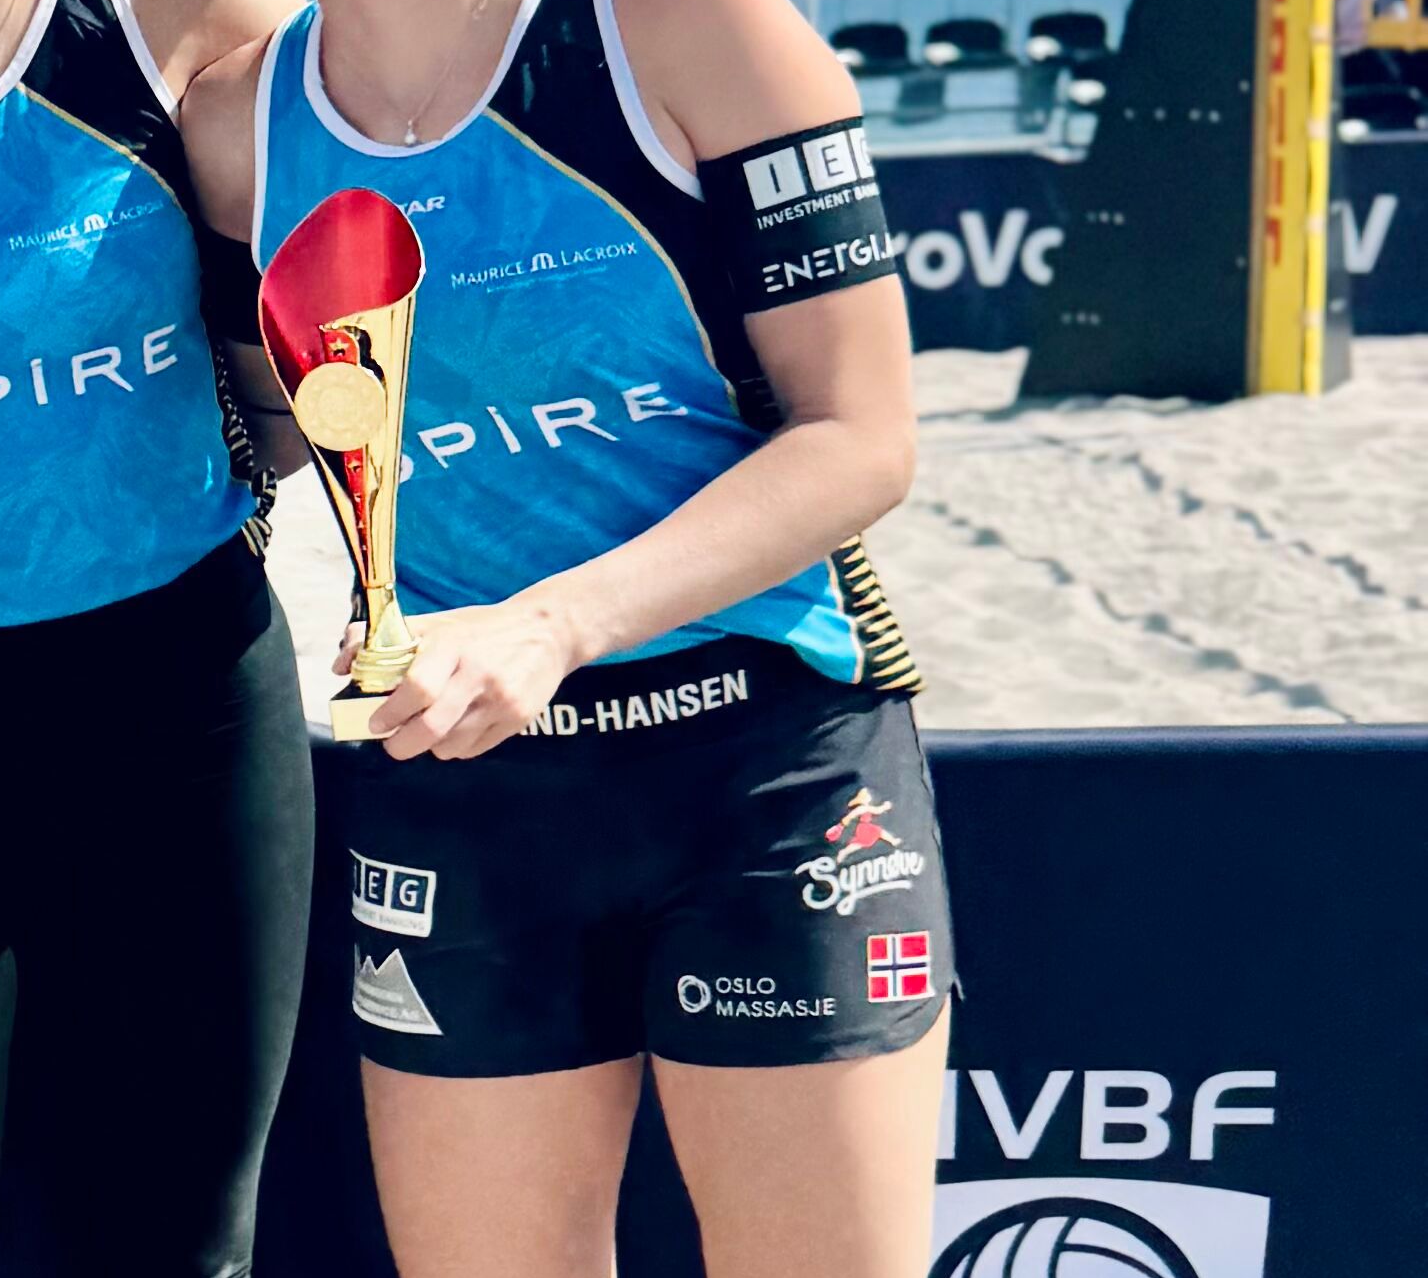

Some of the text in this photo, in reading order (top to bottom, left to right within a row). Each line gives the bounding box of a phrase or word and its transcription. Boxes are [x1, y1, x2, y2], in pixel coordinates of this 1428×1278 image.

[756, 189, 852, 230] INVESTMENT
[8, 222, 81, 251] MAURICE
[451, 260, 525, 289] MAURICE
[560, 241, 638, 267] LACROIX
[399, 382, 689, 483] PIRE
[520, 669, 749, 736] ND-HANSEN
[353, 863, 420, 908] EG
[715, 977, 776, 995] OSLO
[715, 997, 837, 1018] MASSASJE
